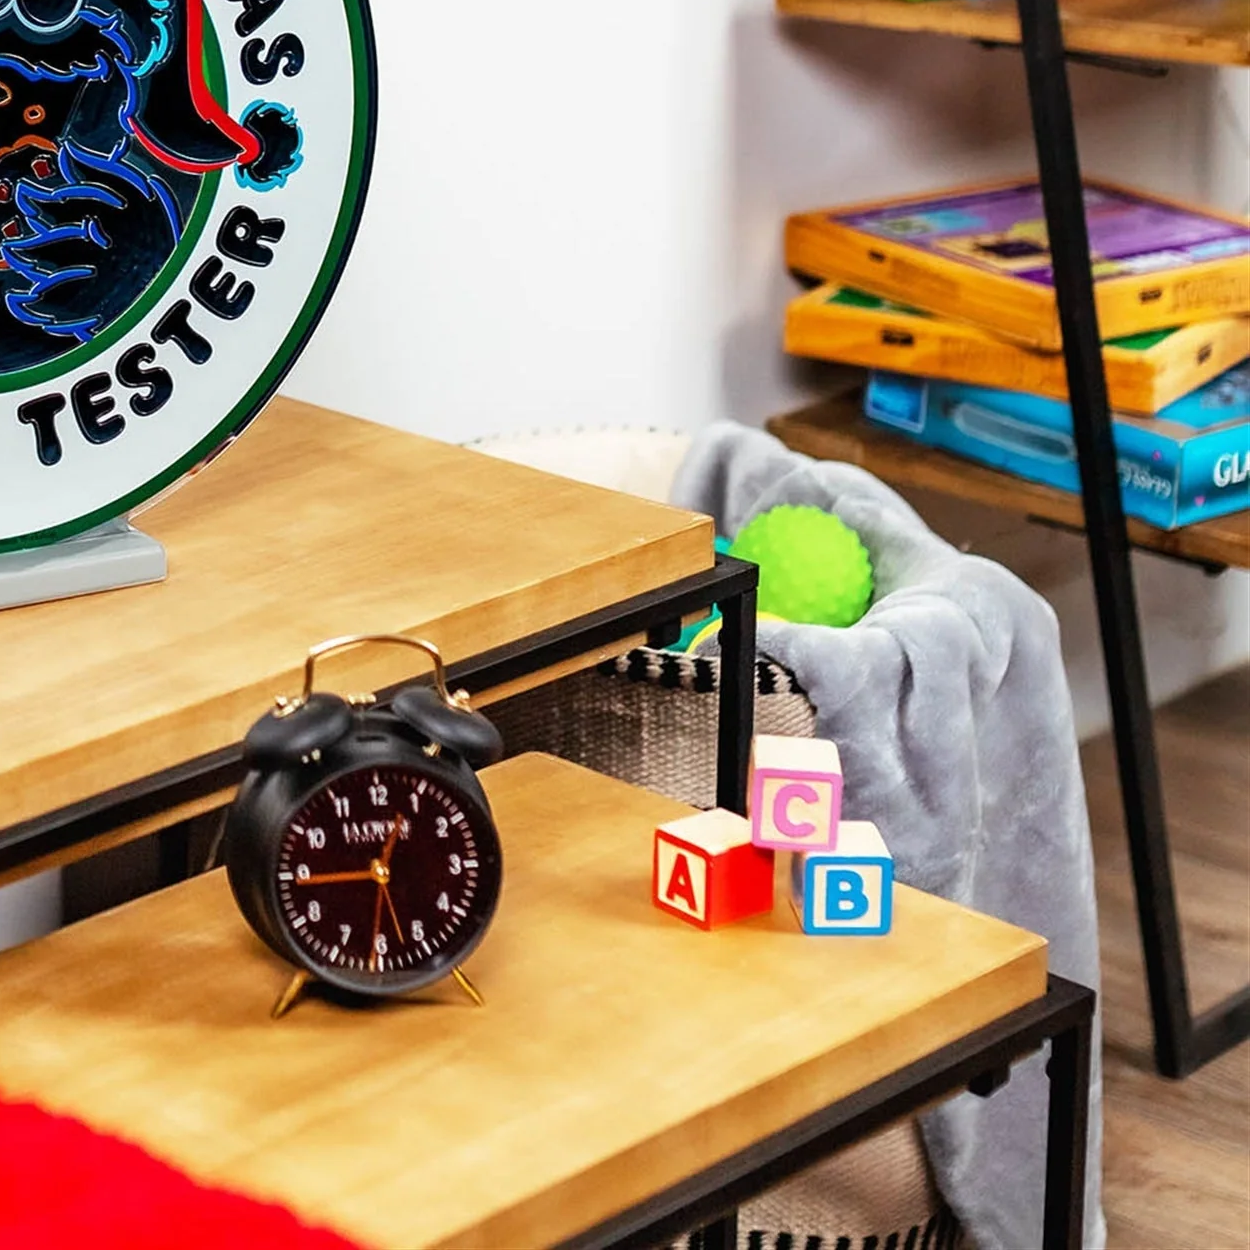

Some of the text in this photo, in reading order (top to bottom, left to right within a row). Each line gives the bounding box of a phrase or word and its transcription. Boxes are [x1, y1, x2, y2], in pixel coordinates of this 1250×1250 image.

[18, 205, 286, 465] TESTER
[368, 784, 389, 806] 12
[410, 792, 419, 814] 1
[334, 796, 350, 818] 11
[772, 783, 820, 838] C
[306, 826, 326, 849] 10
[435, 816, 449, 838] 2
[449, 853, 462, 876] 3
[666, 852, 698, 913] A
[436, 891, 450, 913] 4
[825, 869, 869, 921] B
[307, 900, 321, 923] 8
[339, 923, 351, 946] 7
[411, 919, 424, 941] 5
[375, 933, 388, 955] 6
